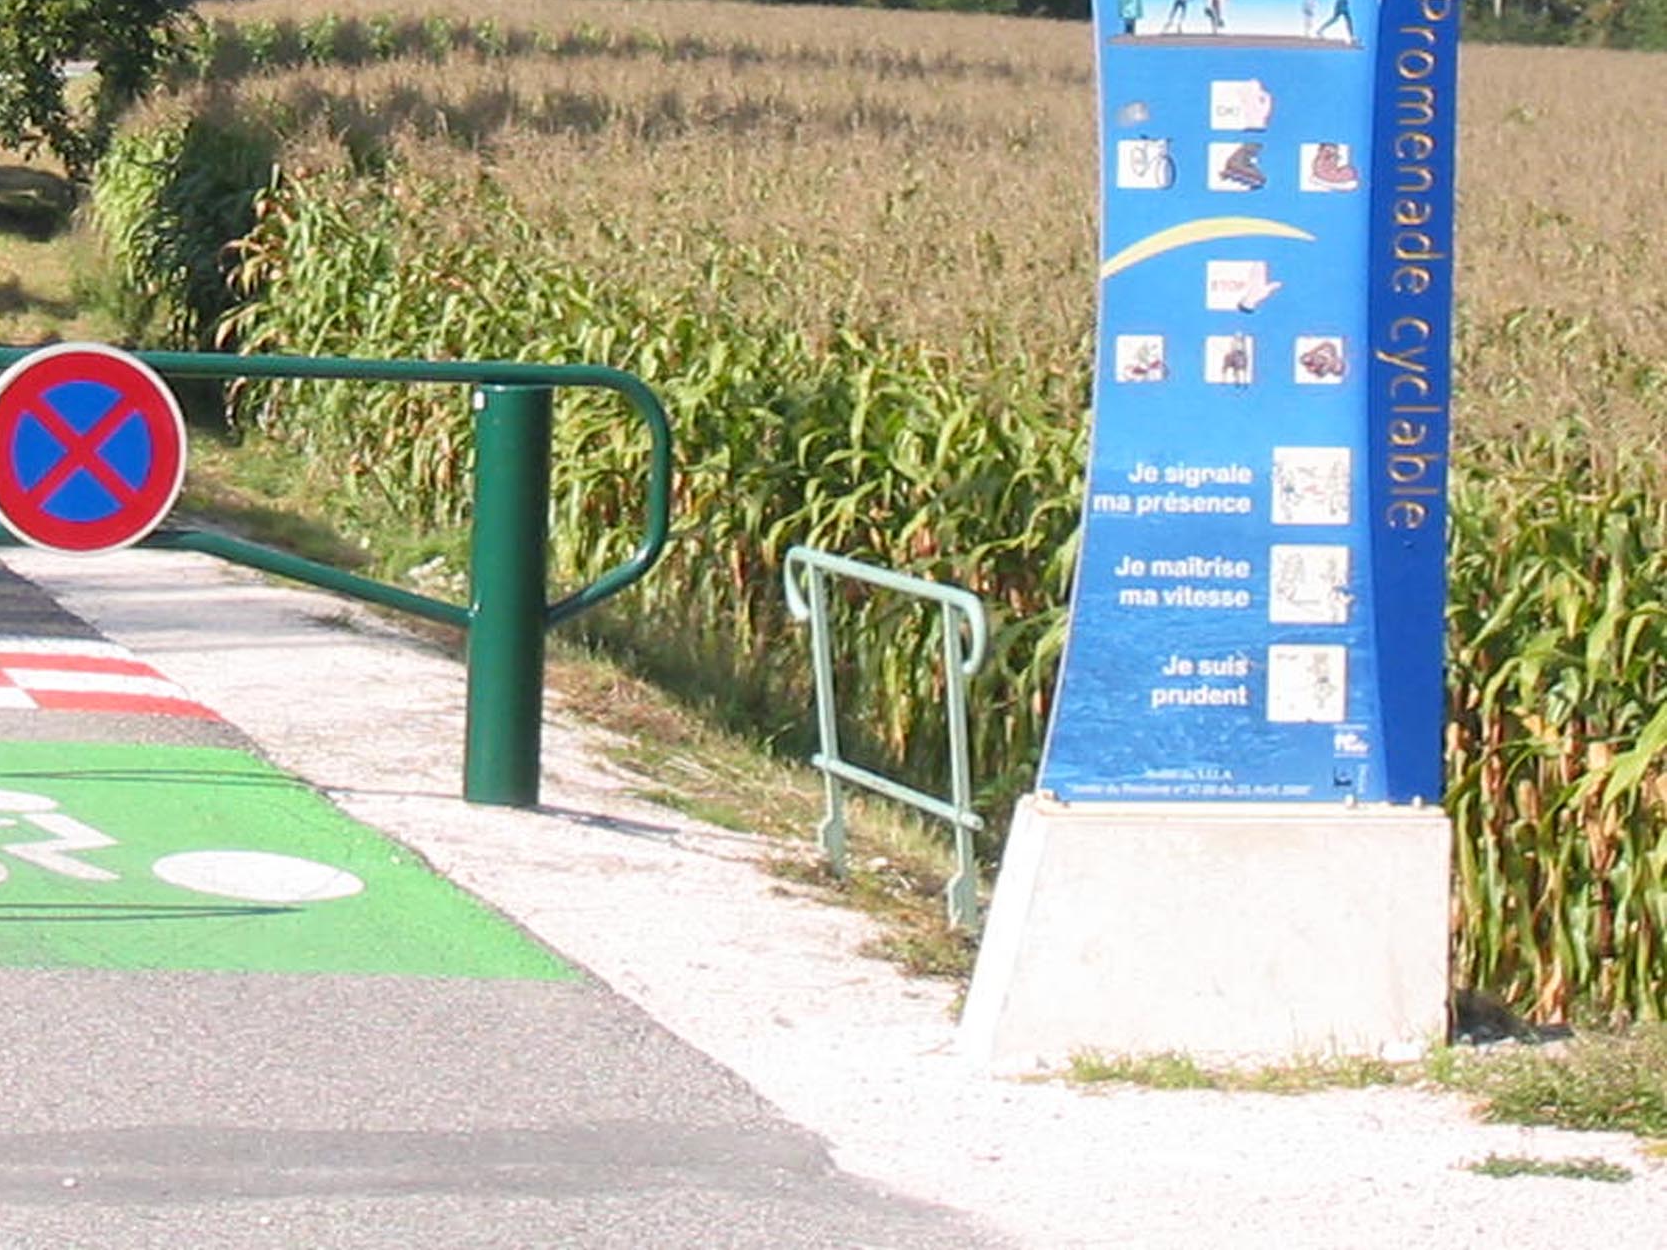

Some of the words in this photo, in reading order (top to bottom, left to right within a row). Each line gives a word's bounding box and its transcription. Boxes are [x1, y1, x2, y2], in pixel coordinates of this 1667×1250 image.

[1375, 315, 1443, 530] cyclable
[1127, 462, 1159, 484] Je
[1164, 462, 1253, 489] signale
[1092, 494, 1132, 512] ma
[1136, 490, 1252, 517] présence
[1114, 555, 1146, 577] Je
[1150, 555, 1252, 579] maîtrise
[1118, 588, 1159, 606] ma
[1162, 585, 1251, 608] vitesse
[1161, 654, 1194, 677] Je
[1197, 654, 1250, 678] suis
[1150, 683, 1250, 709] prudent
